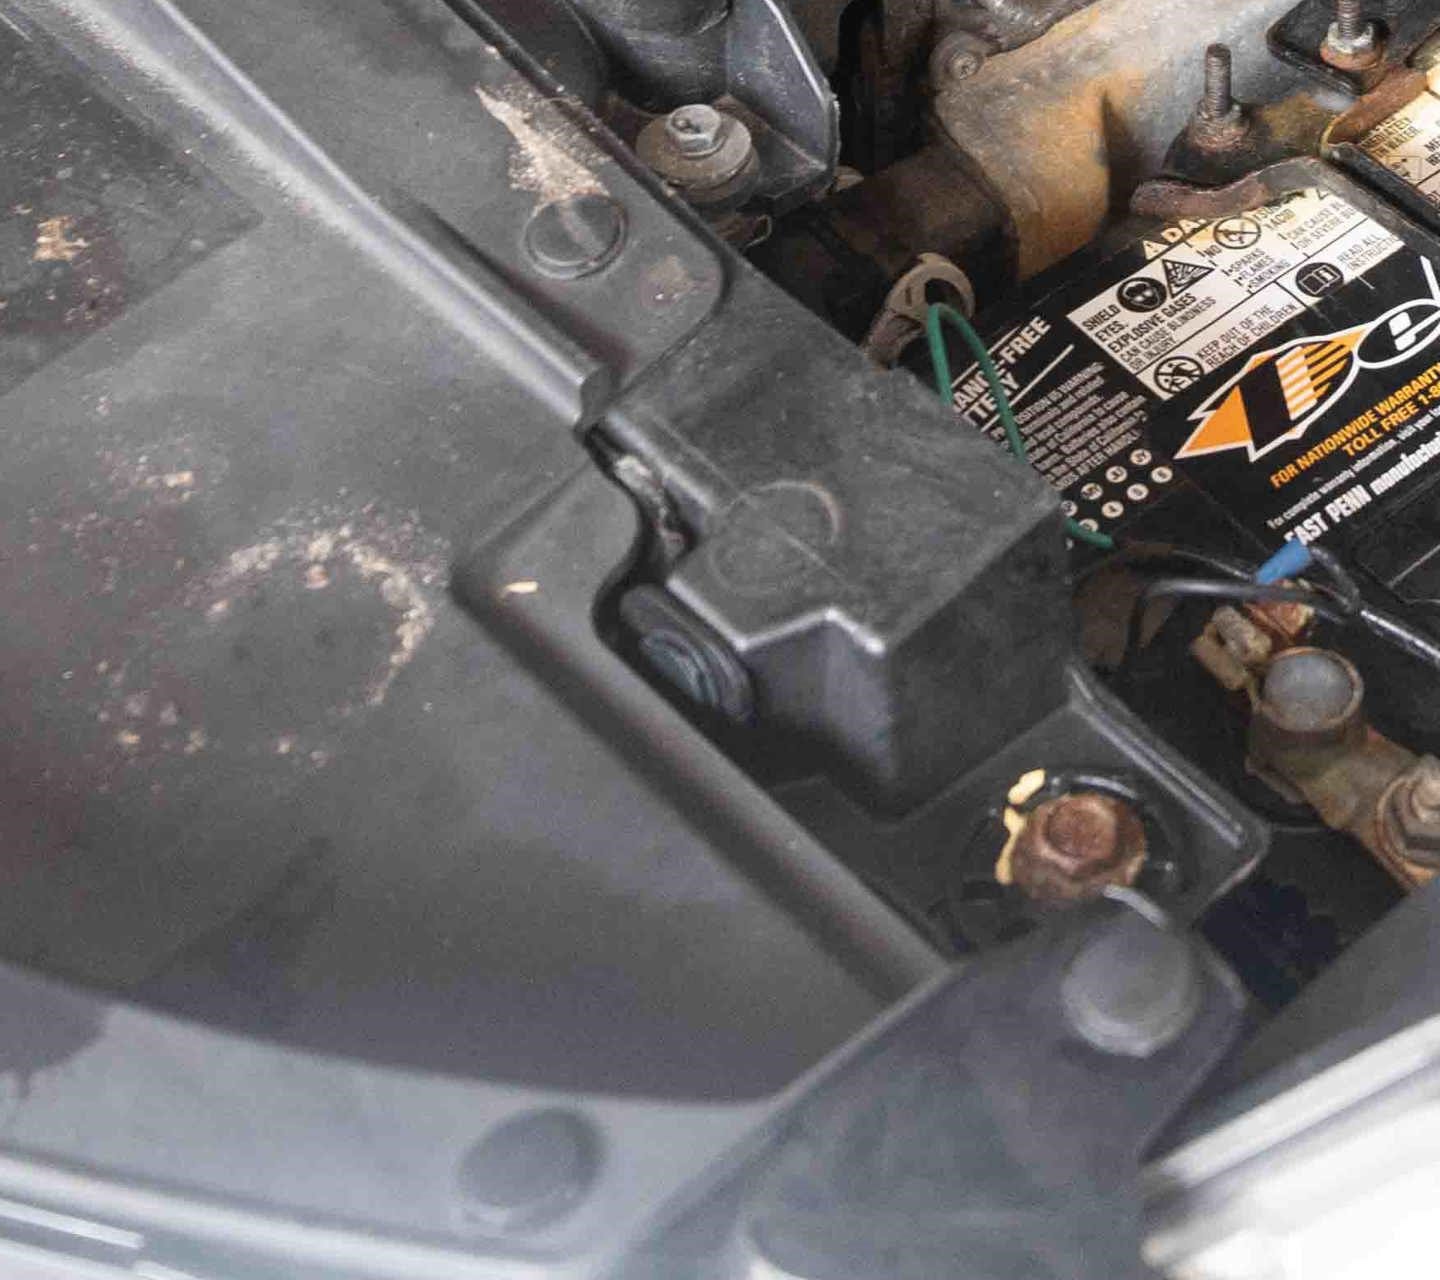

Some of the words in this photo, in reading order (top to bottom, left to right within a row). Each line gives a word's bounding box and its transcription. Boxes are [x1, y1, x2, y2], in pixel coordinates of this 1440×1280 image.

[1203, 243, 1223, 258] NO
[1335, 242, 1364, 263] READ
[1359, 231, 1380, 246] ALL
[1080, 302, 1122, 332] SHIELD
[1093, 317, 1128, 343] EYES.
[1106, 312, 1166, 354] EXPLOSIVE
[1159, 291, 1198, 319] GASES
[1118, 345, 1142, 363] CAN
[1137, 326, 1171, 350] CAUSE
[1165, 294, 1218, 331] BLINDNESS
[1195, 339, 1224, 360] KEEP
[1218, 325, 1244, 344] OUT
[1238, 316, 1256, 330] OF
[1252, 304, 1274, 320] THE
[1204, 341, 1241, 368] REACH
[1235, 332, 1254, 346] OF
[1248, 301, 1299, 338] CHILDREN
[1128, 356, 1146, 370] OR
[1141, 335, 1178, 361] INJURY
[1267, 462, 1302, 489] FOR
[1293, 407, 1380, 471] NATIONWIDE
[1340, 424, 1385, 458] TOLL
[1378, 399, 1421, 432] FREE
[1321, 482, 1375, 523] PENN
